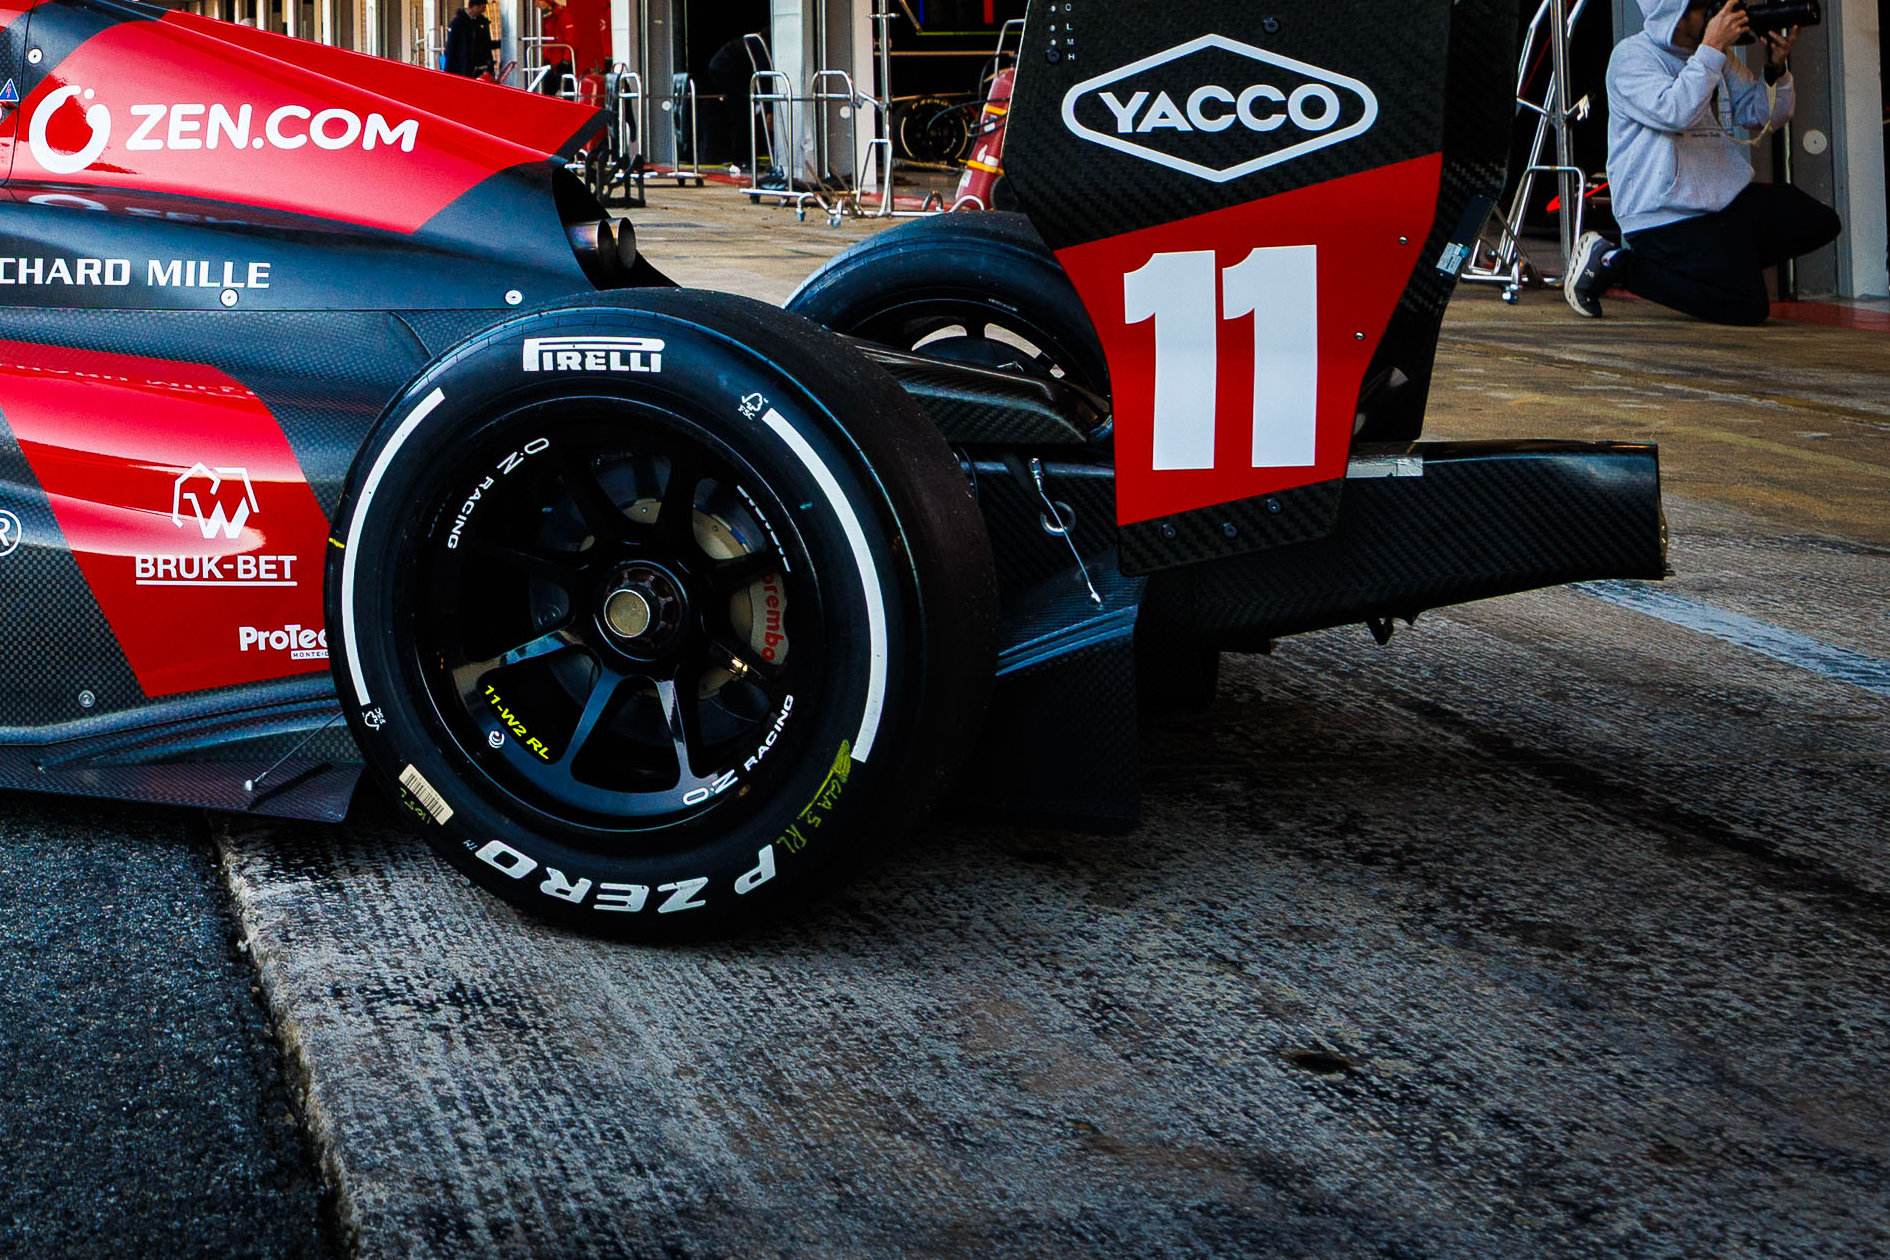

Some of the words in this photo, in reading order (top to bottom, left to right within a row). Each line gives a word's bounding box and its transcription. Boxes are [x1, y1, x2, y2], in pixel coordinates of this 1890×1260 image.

[126, 101, 420, 153] ZEN.COM
[1098, 83, 1341, 135] YACCO
[146, 258, 272, 290] MILLE
[521, 336, 665, 373] PIRELLI
[1122, 244, 1319, 472] 11
[737, 404, 756, 421] FSC
[446, 476, 494, 550] RACING
[134, 554, 298, 580] BRUK-BET
[483, 684, 527, 738] 11-W2
[526, 736, 551, 761] RL
[742, 693, 796, 772] RACING
[474, 838, 709, 915] ZERO
[734, 842, 780, 897] P
